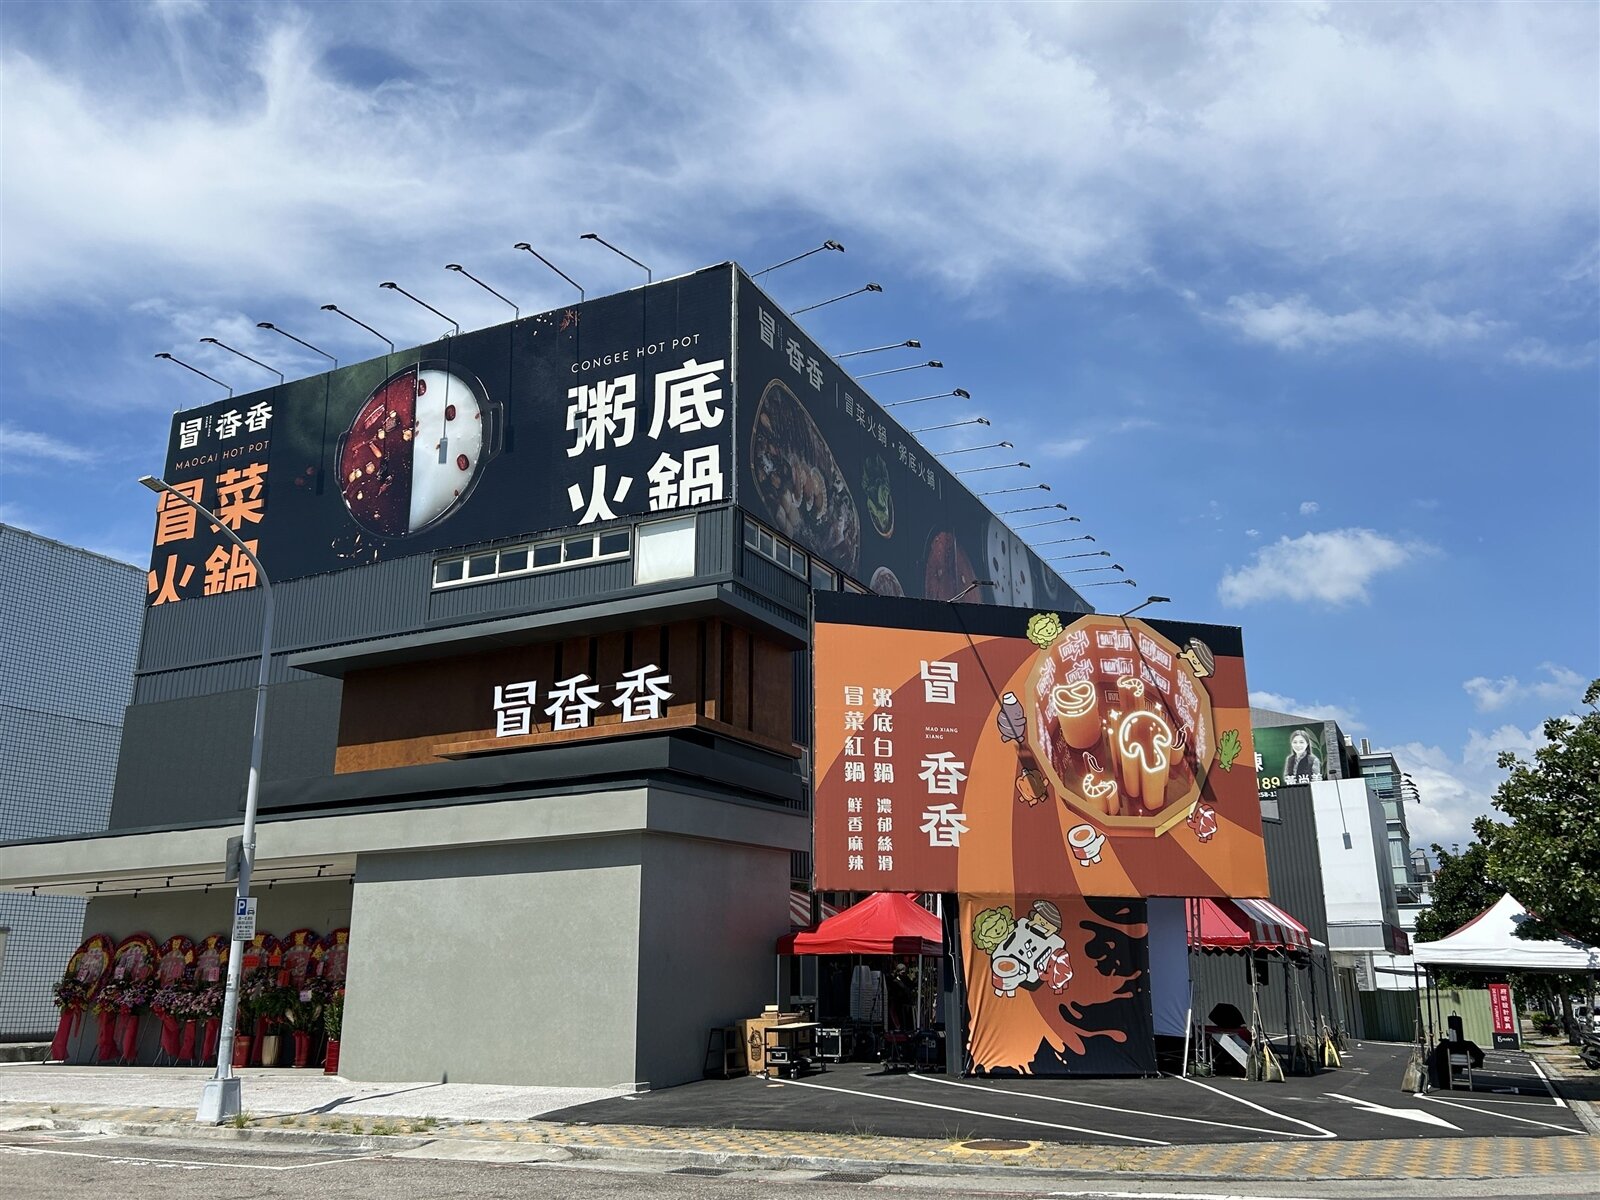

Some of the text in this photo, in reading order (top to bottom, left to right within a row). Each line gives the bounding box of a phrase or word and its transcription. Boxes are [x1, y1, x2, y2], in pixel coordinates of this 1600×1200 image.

[571, 334, 700, 374] CONGEE HOT POT
[758, 305, 824, 392] 冒香香
[179, 401, 273, 450] 冒香香
[566, 358, 725, 458] 粥底
[175, 440, 270, 471] MAOCAI HOT POT
[567, 444, 724, 526] 火鍋
[156, 462, 269, 546] 冒菜
[148, 539, 259, 606] 火鍋
[493, 663, 675, 738] 冒香香
[844, 686, 865, 871] 冒菜紅鍋 鮮香麻辣
[872, 687, 894, 871] 粥底白鍋 濃郁絲滑
[238, 900, 246, 914] P
